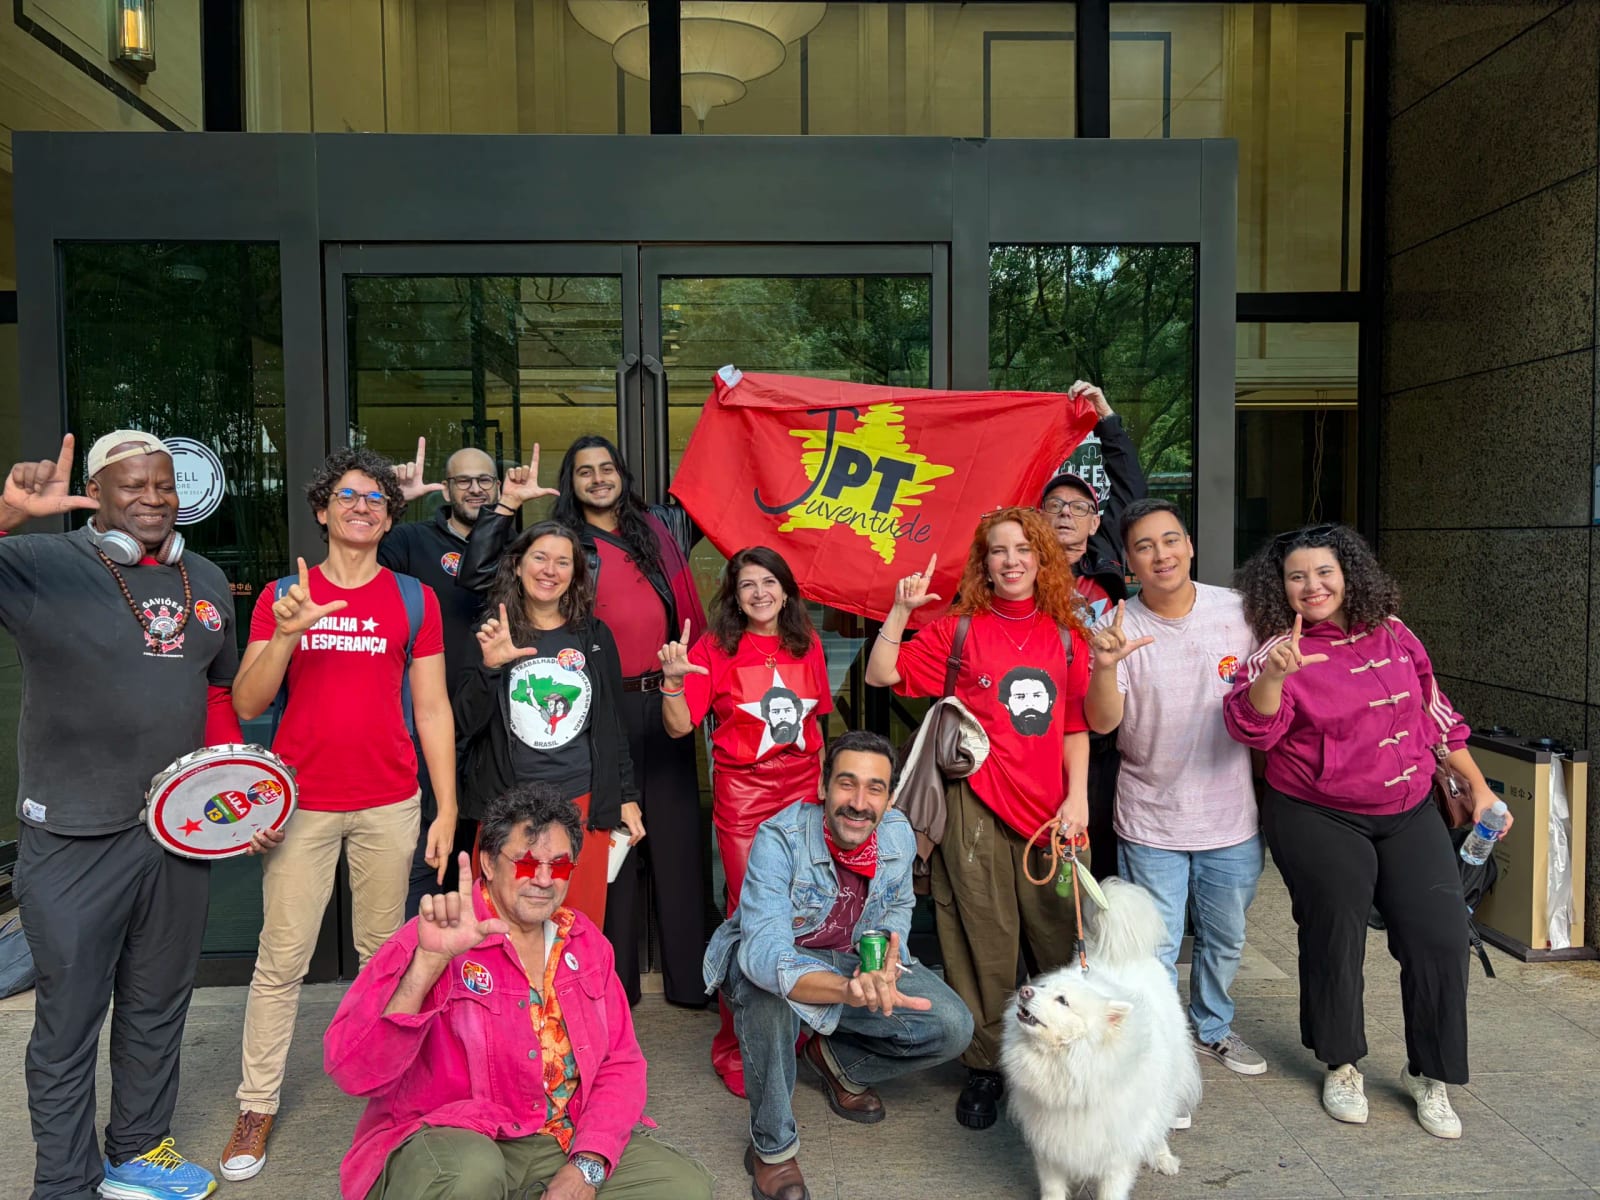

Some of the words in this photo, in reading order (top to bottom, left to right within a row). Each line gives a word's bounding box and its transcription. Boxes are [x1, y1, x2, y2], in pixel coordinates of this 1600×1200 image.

[176, 471, 199, 482] ELL
[301, 634, 309, 651] A
[311, 633, 387, 656] ESPERANÇA
[515, 658, 558, 672] TRABALHAD
[533, 740, 559, 748] BRASIL
[226, 792, 248, 815] LULA
[207, 807, 223, 821] 13
